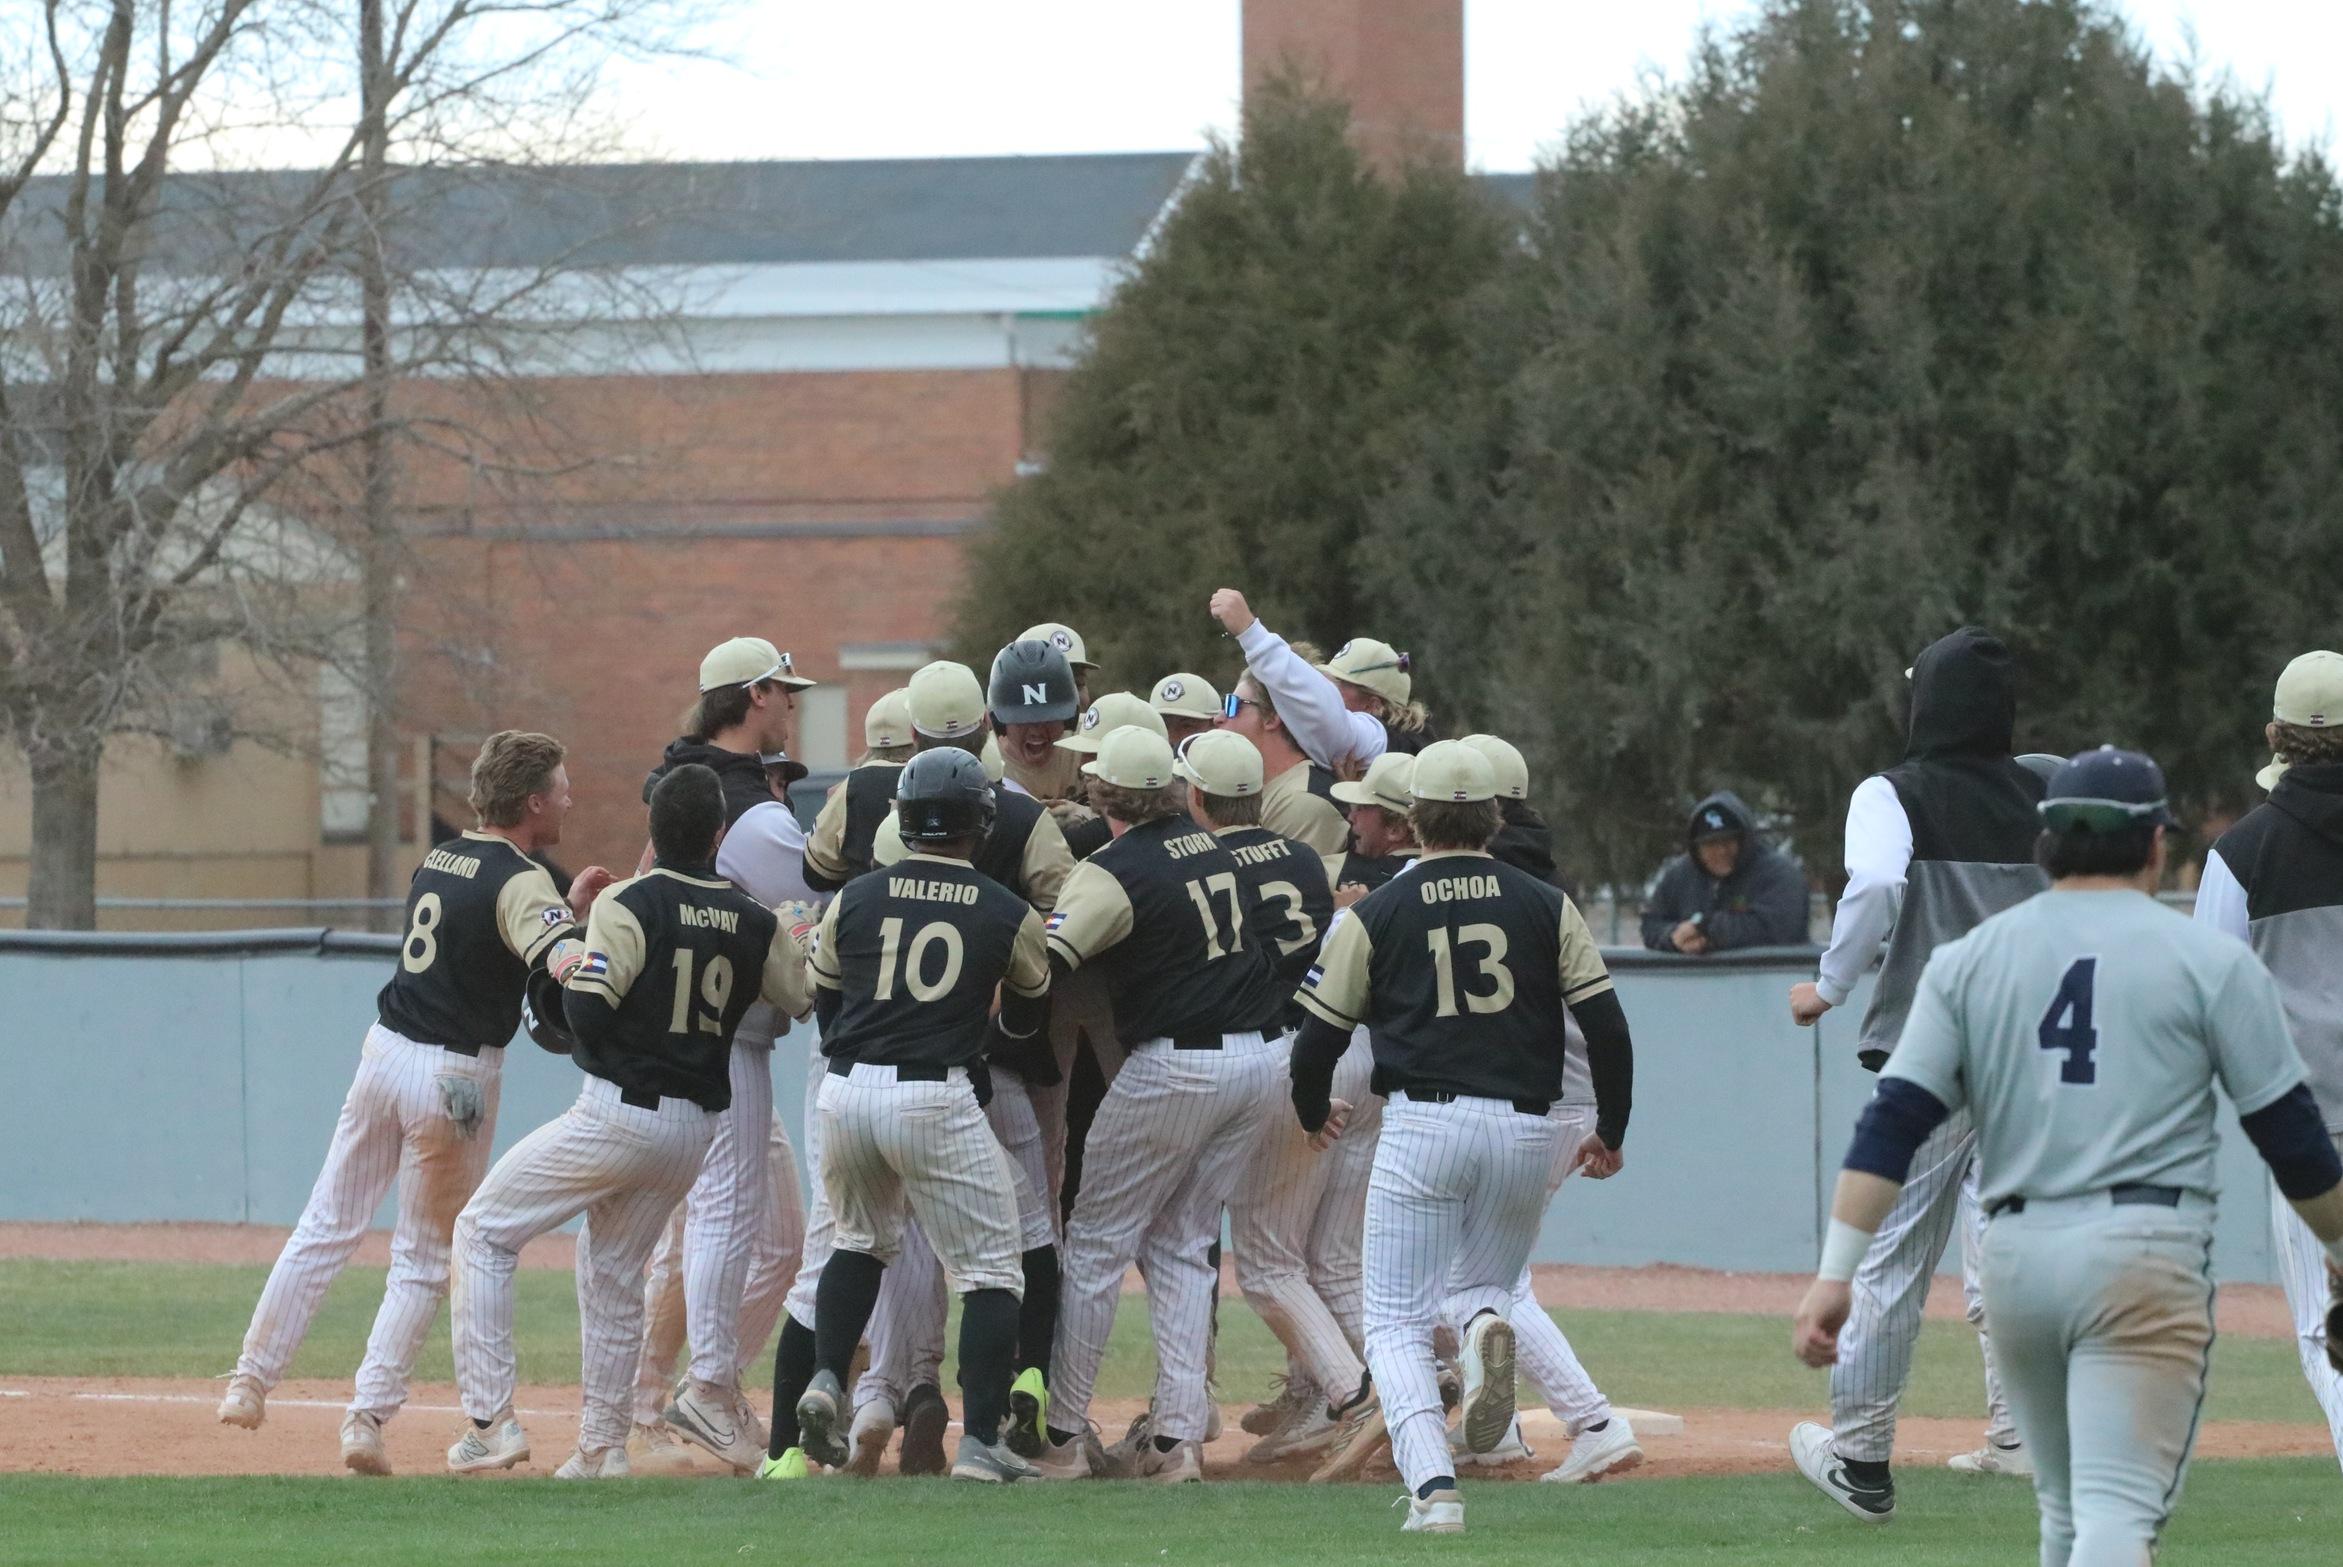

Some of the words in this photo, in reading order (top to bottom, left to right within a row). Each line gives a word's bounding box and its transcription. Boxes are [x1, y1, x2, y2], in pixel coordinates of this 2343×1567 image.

[1022, 683, 1047, 706] N
[1167, 687, 1178, 695] N
[549, 910, 562, 921] N
[679, 903, 740, 934] McVAY
[888, 877, 979, 905] VALERIO
[1185, 872, 1244, 961] 17
[1259, 880, 1317, 957] 3
[1421, 875, 1501, 905] OCHOA
[403, 892, 442, 974] 8
[873, 917, 964, 1002] 10
[1427, 922, 1515, 1018] 13
[668, 947, 734, 1037] 19
[2038, 955, 2098, 1086] 4
